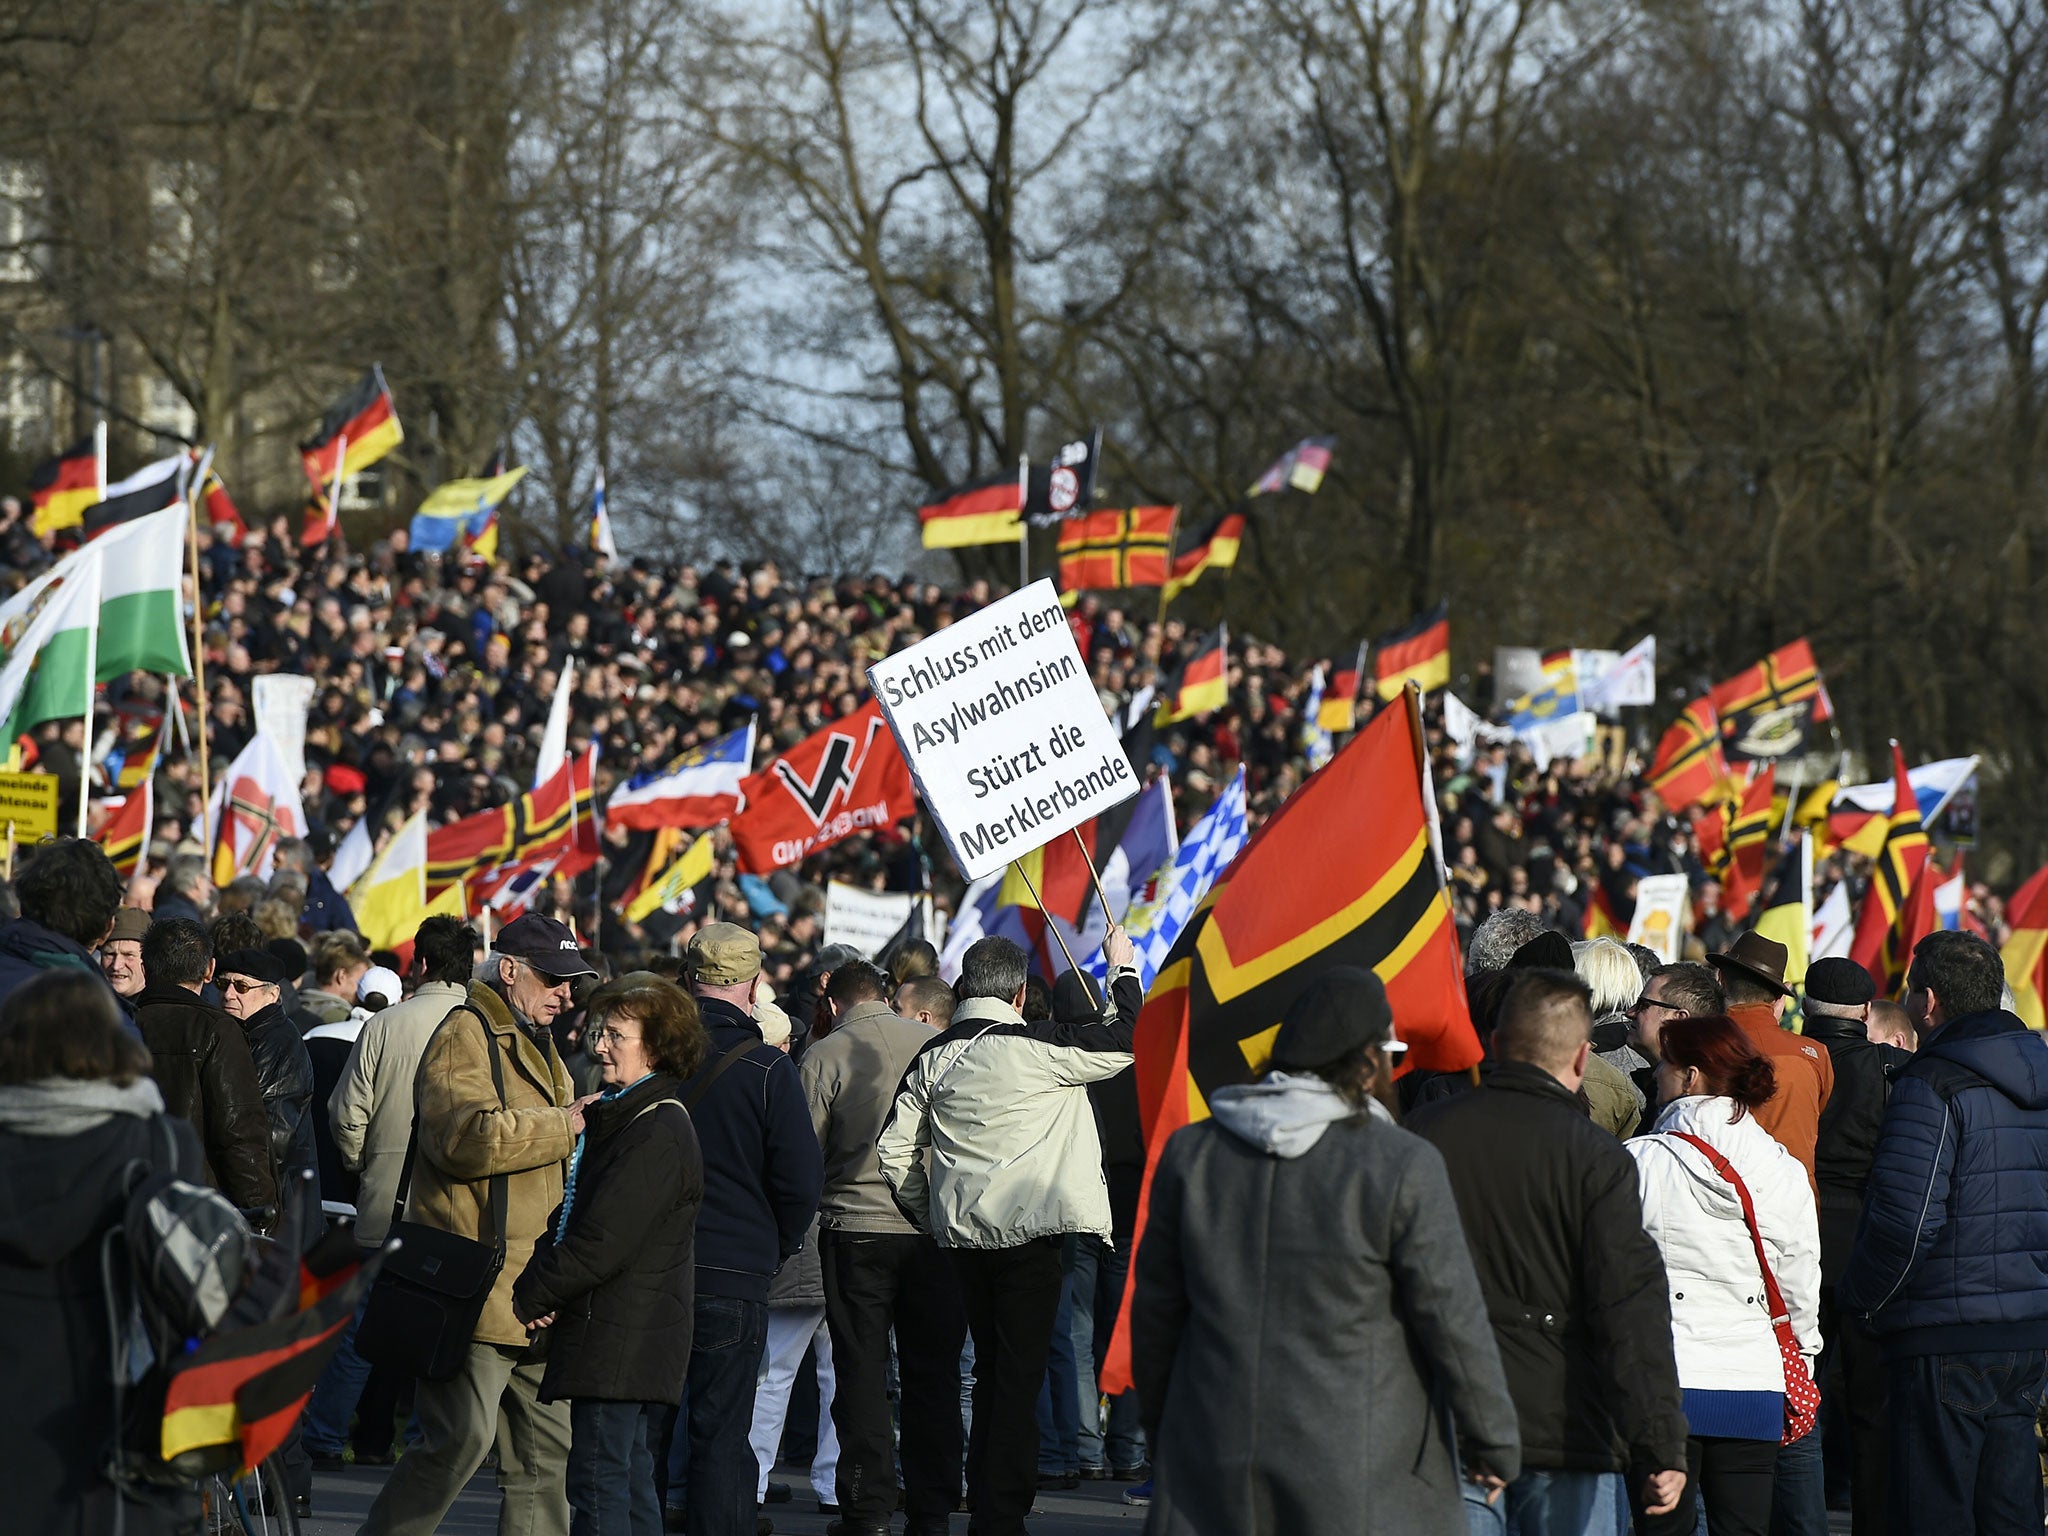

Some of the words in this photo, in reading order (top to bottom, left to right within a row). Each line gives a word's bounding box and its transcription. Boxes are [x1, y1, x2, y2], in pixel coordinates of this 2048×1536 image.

[883, 645, 978, 707] Schluss
[978, 625, 1017, 660] mit
[1019, 603, 1064, 640] dem
[912, 654, 1077, 753] Asylwahnsinn
[959, 755, 1129, 860] Merklerbande
[967, 742, 1047, 798] Stürzt
[1050, 723, 1086, 759] die
